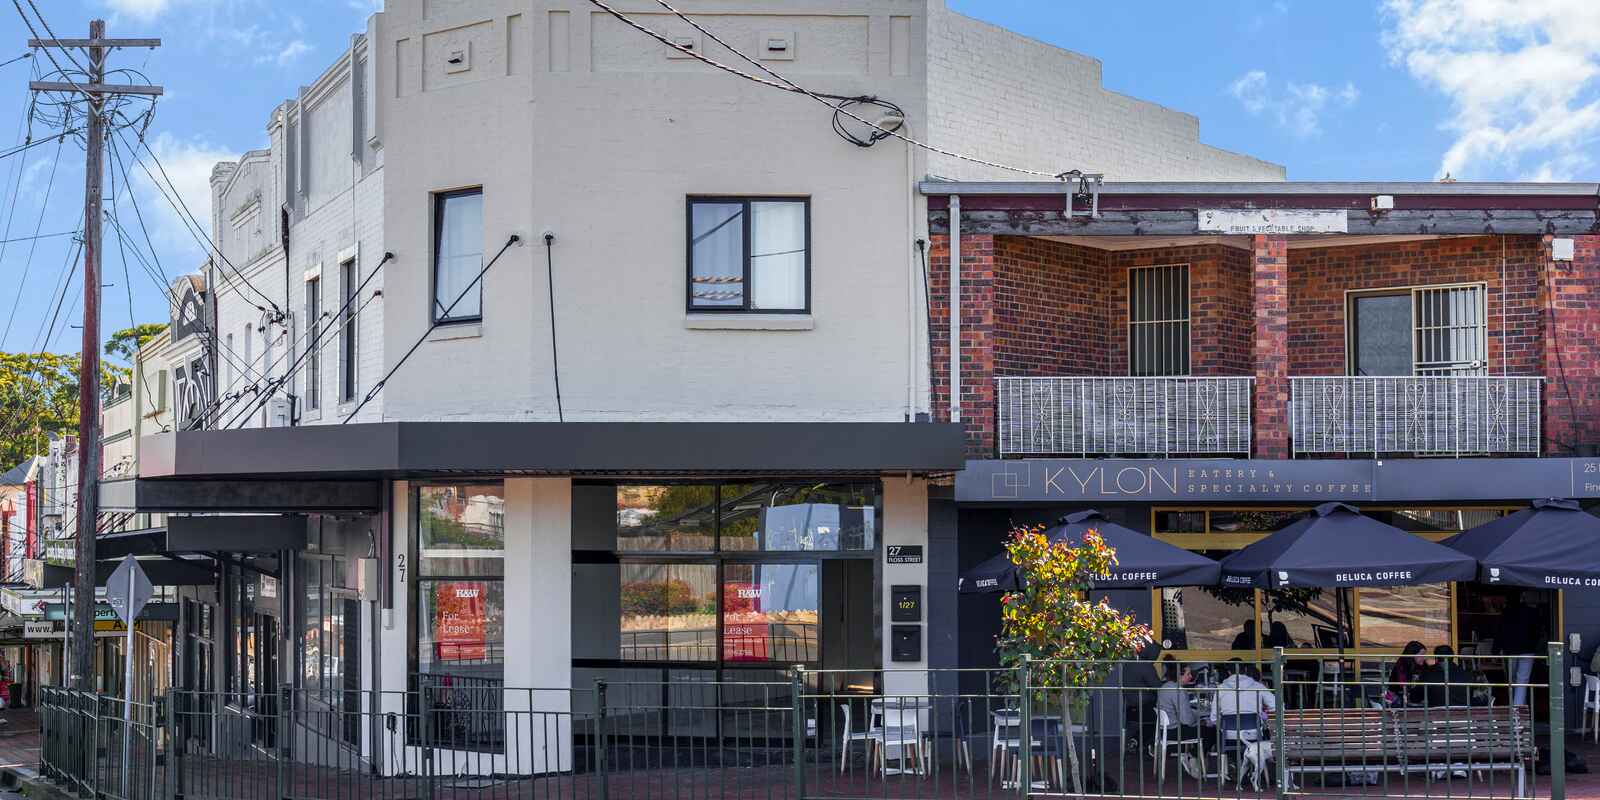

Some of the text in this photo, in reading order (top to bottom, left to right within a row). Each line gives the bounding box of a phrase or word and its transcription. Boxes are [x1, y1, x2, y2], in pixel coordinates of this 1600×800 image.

[1584, 463, 1597, 473] 25
[1187, 469, 1256, 478] EATERY
[1045, 467, 1176, 494] KYLON
[1187, 484, 1372, 493] SPECIALTY COFFEE
[889, 547, 902, 556] 27
[1122, 572, 1157, 580] COFFEE
[1336, 571, 1412, 582] DELUCA COFFEE
[1544, 576, 1581, 585] DELUCA
[442, 612, 459, 621] For
[442, 624, 470, 634] Lease
[724, 625, 753, 635] Lease
